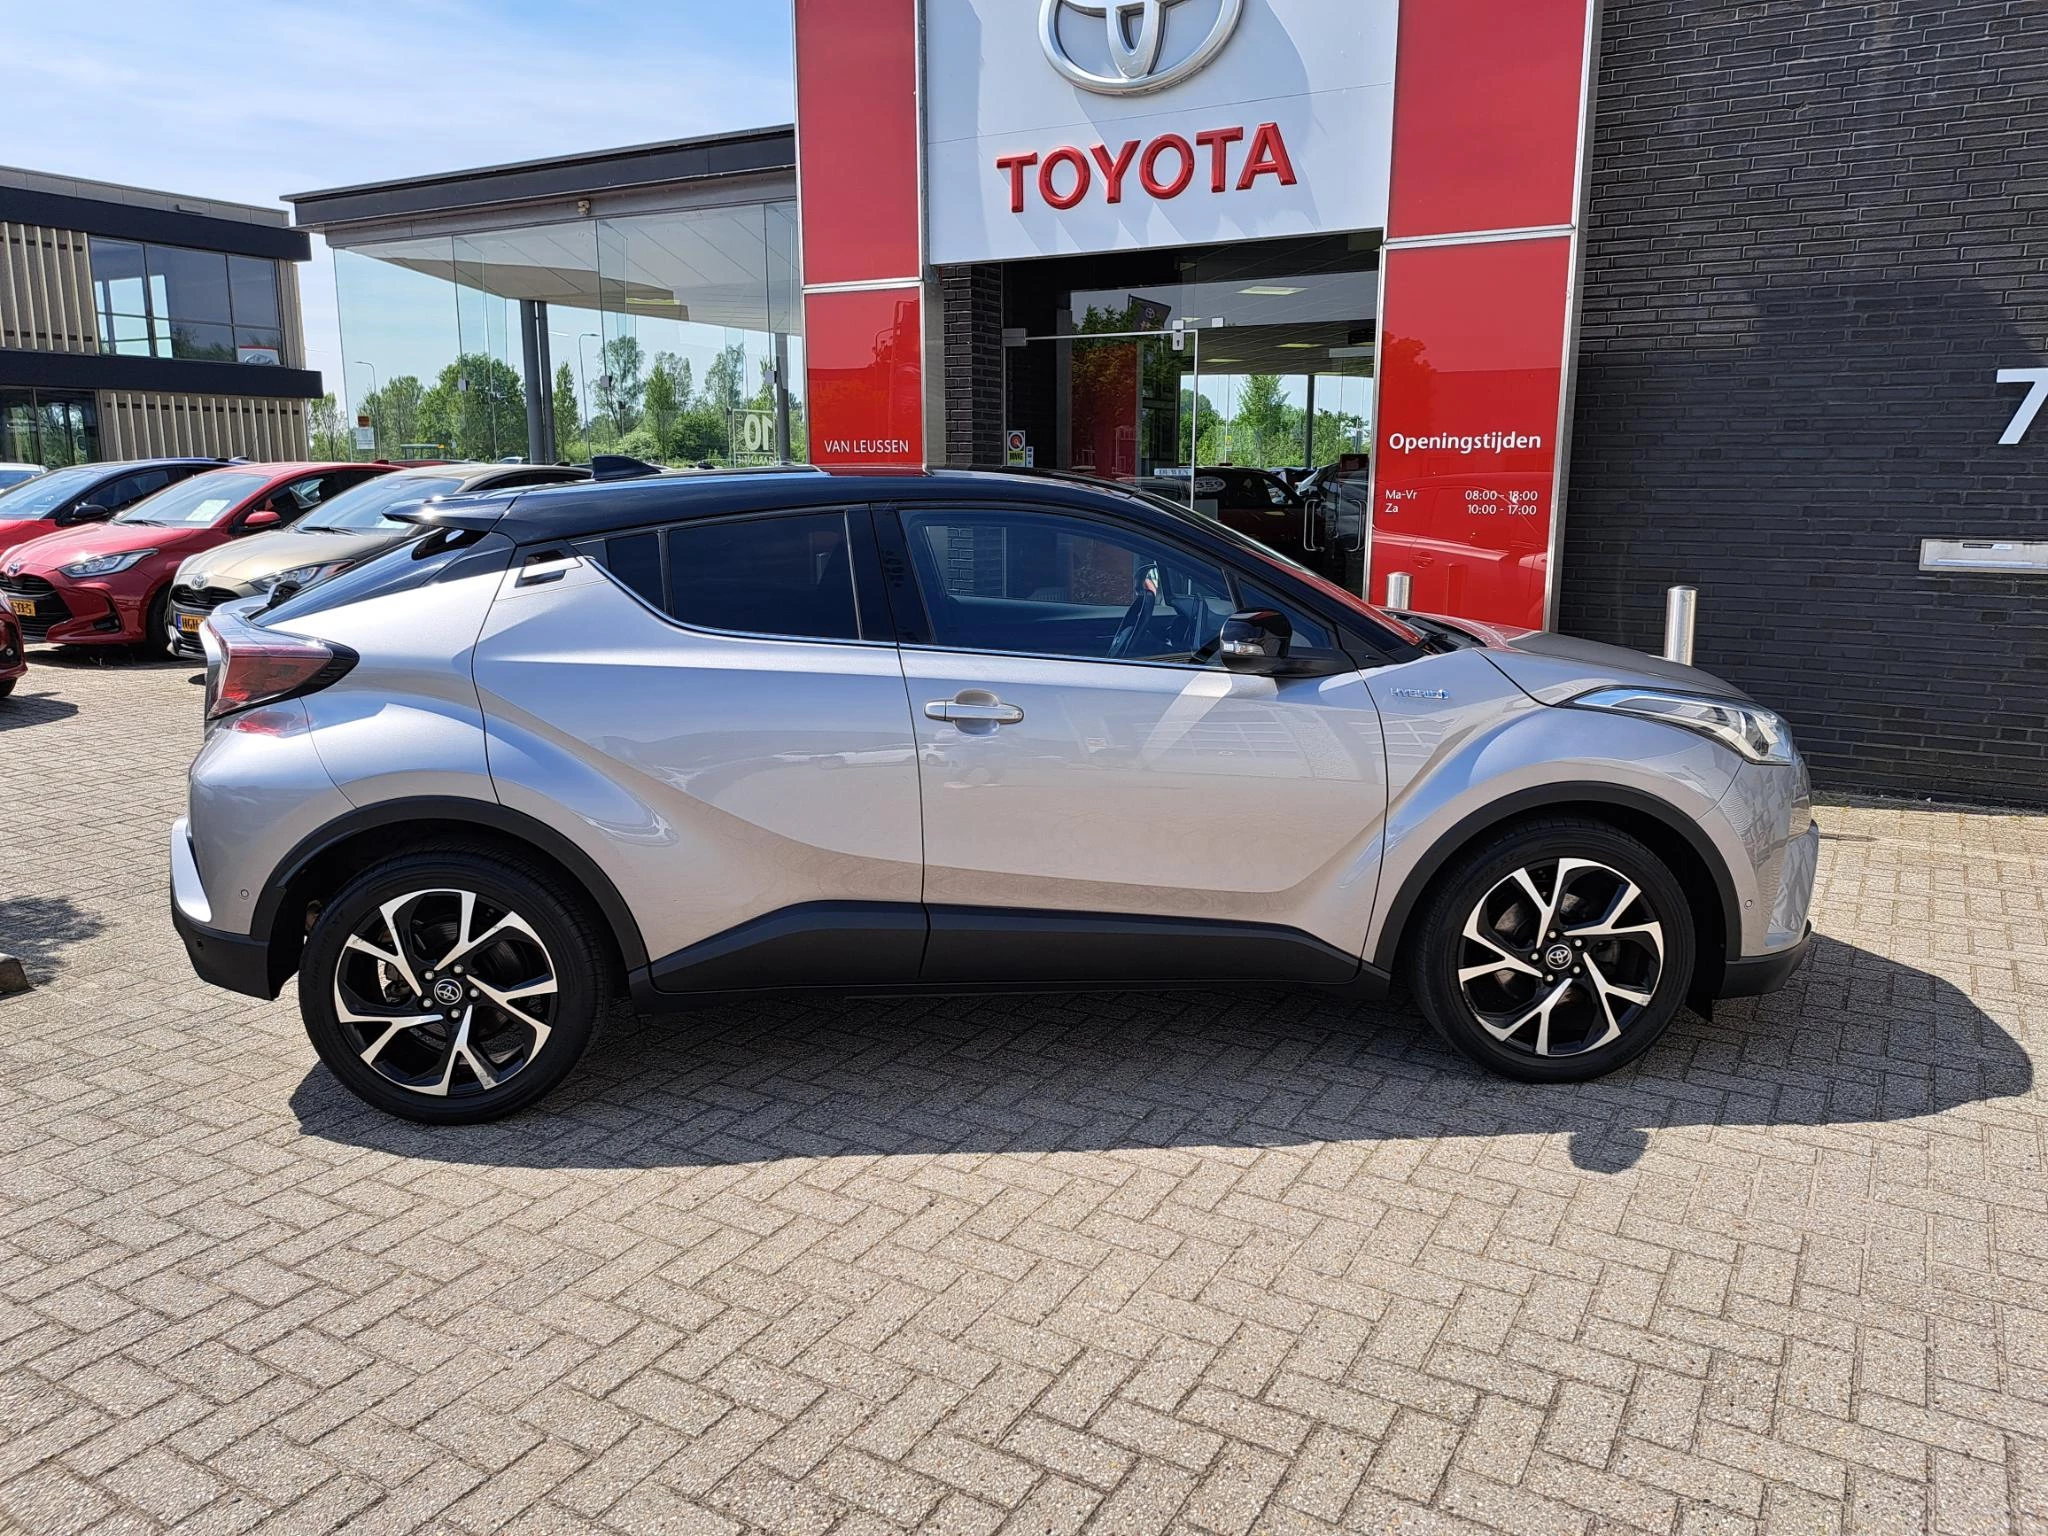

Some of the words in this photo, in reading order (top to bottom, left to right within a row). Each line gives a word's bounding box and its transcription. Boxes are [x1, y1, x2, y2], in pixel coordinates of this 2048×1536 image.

[995, 121, 1298, 214] TOYOTA
[1996, 367, 2048, 445] 7
[823, 439, 850, 453] VAN
[853, 439, 909, 453] LEUSSEN
[1388, 431, 1541, 454] Openingstijden
[1385, 489, 1418, 500] Ma-Vr
[1464, 490, 1498, 501] 08:00
[1508, 490, 1539, 501] 18:00
[1385, 502, 1399, 513] Za
[1467, 504, 1497, 515] 10:00
[1508, 504, 1537, 515] 17:00
[1390, 687, 1440, 699] HYBRID
